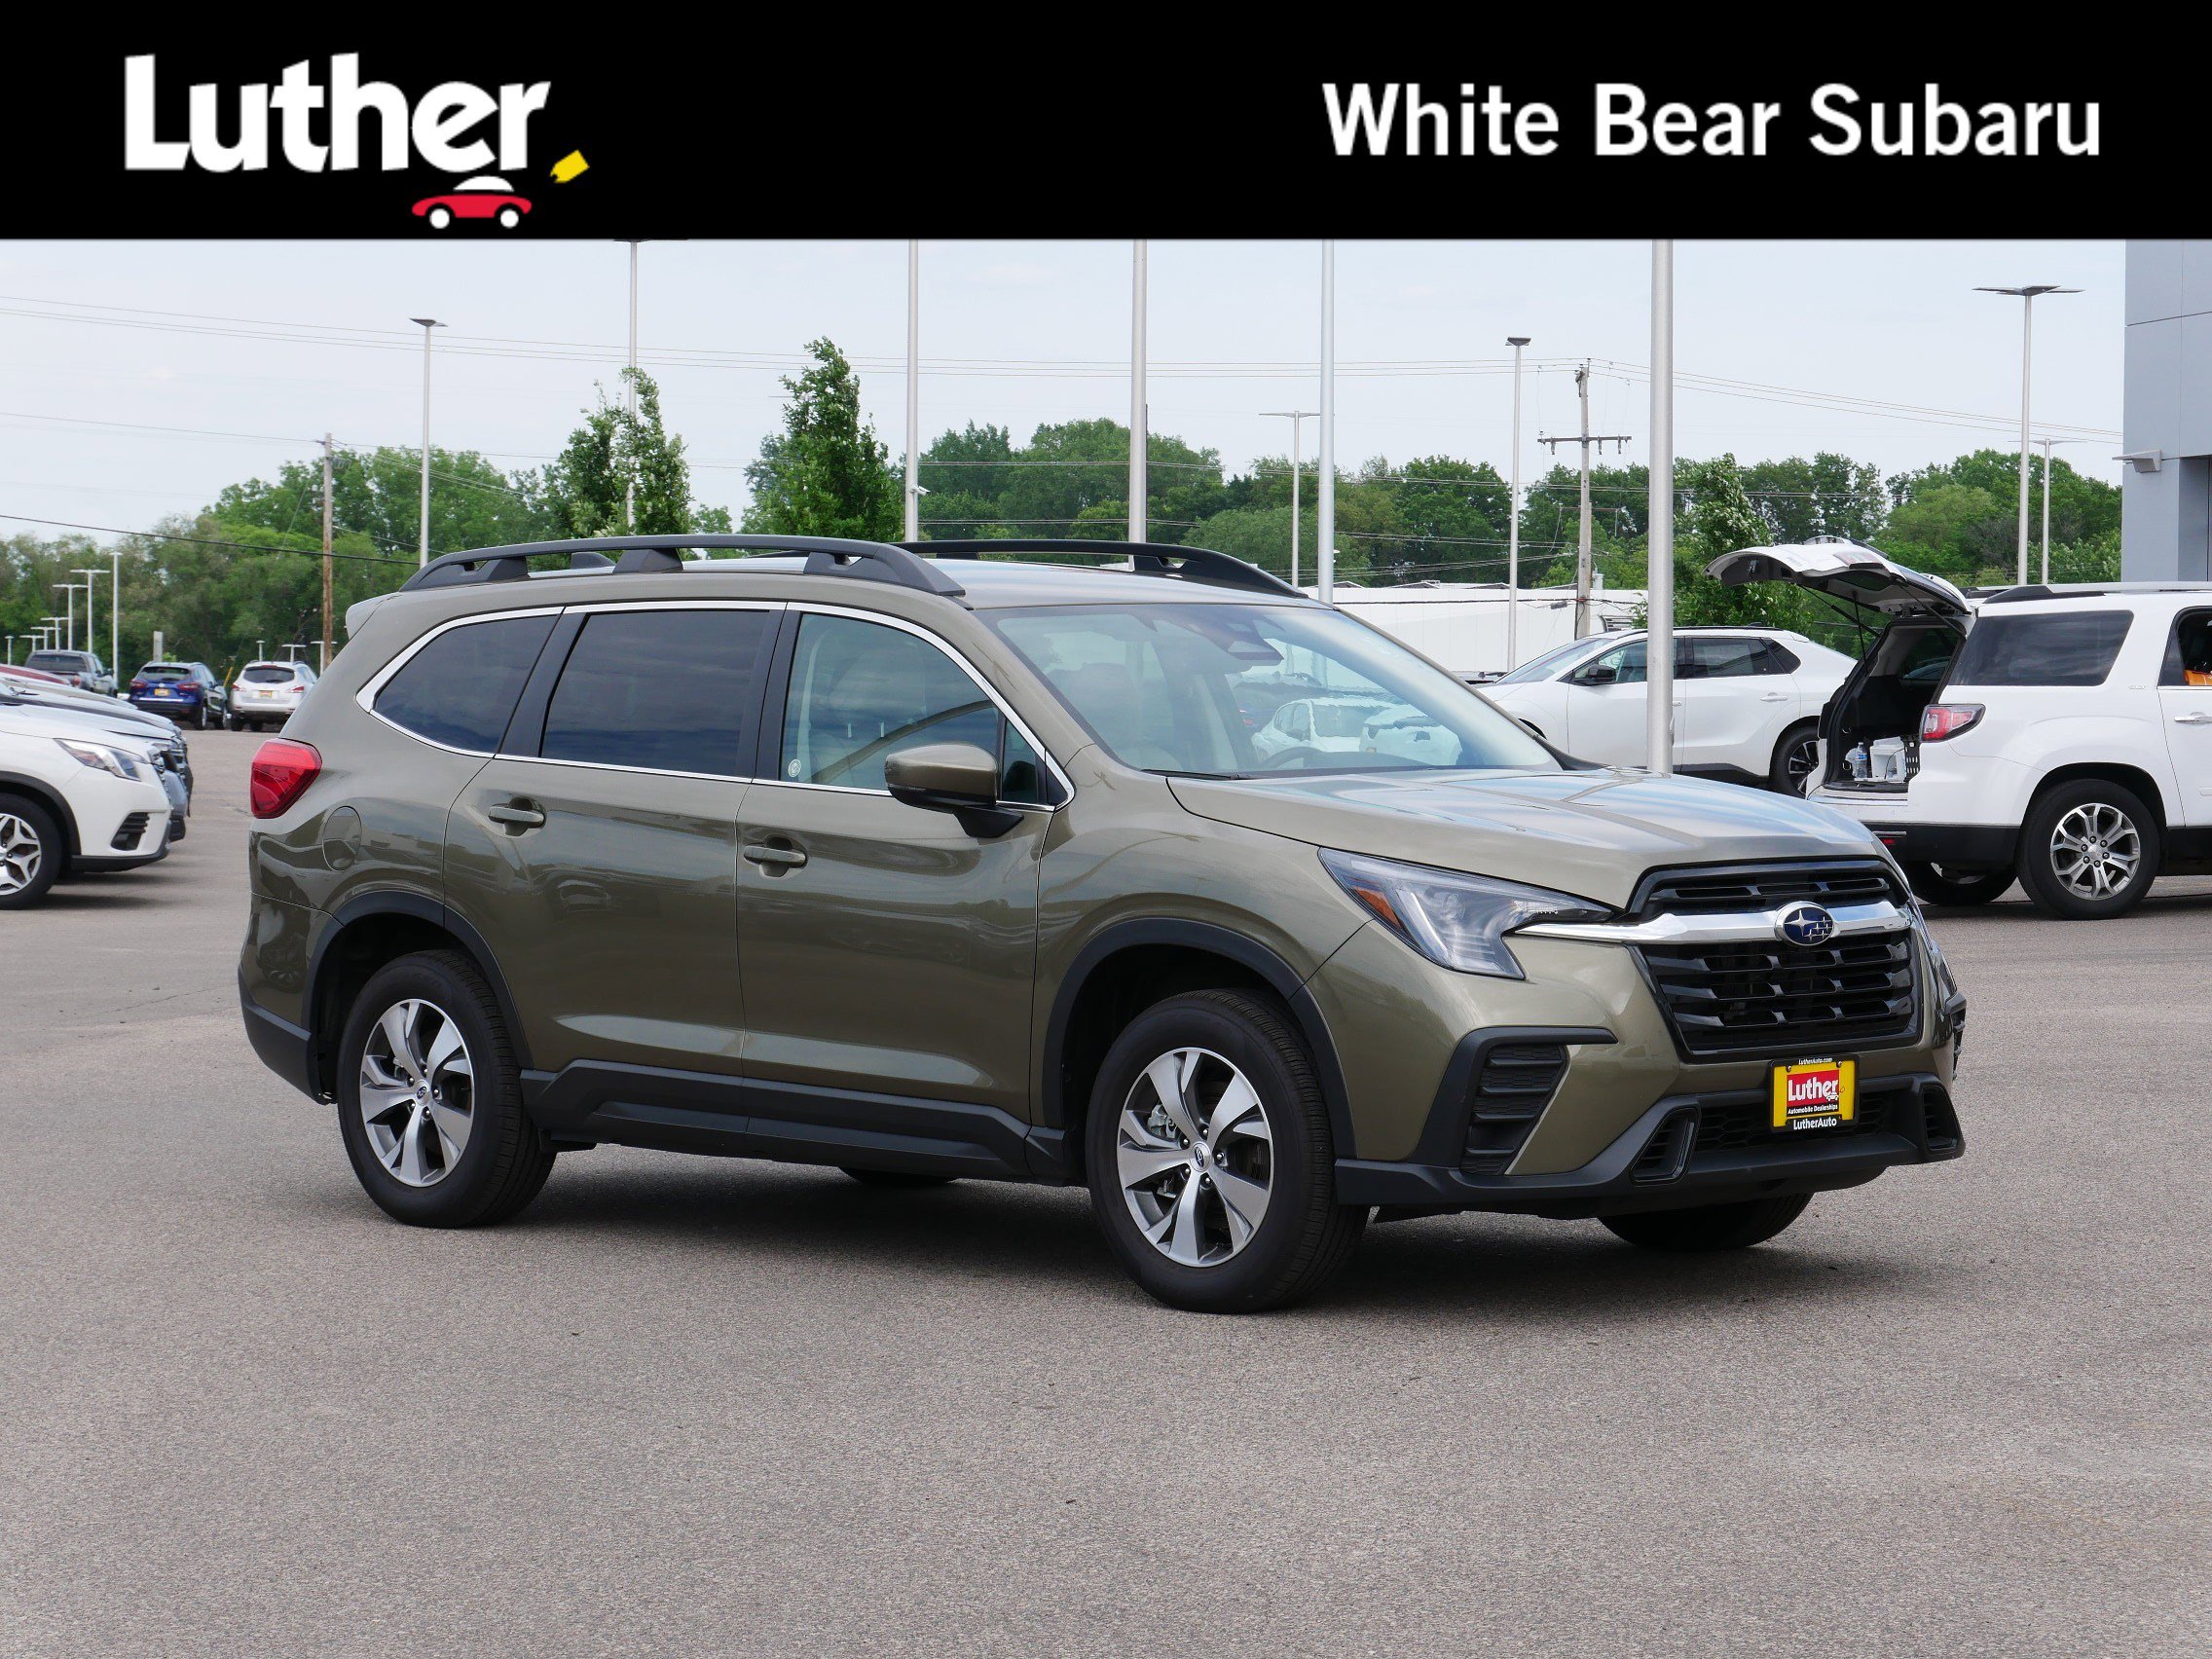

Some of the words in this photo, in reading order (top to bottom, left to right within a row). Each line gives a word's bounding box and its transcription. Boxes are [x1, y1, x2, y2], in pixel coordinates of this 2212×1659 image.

[1788, 1077, 1838, 1102] Luther
[1788, 1105, 1813, 1115] Automobile
[1814, 1103, 1838, 1112] Dealerships
[1793, 1117, 1837, 1130] LutherAuto
